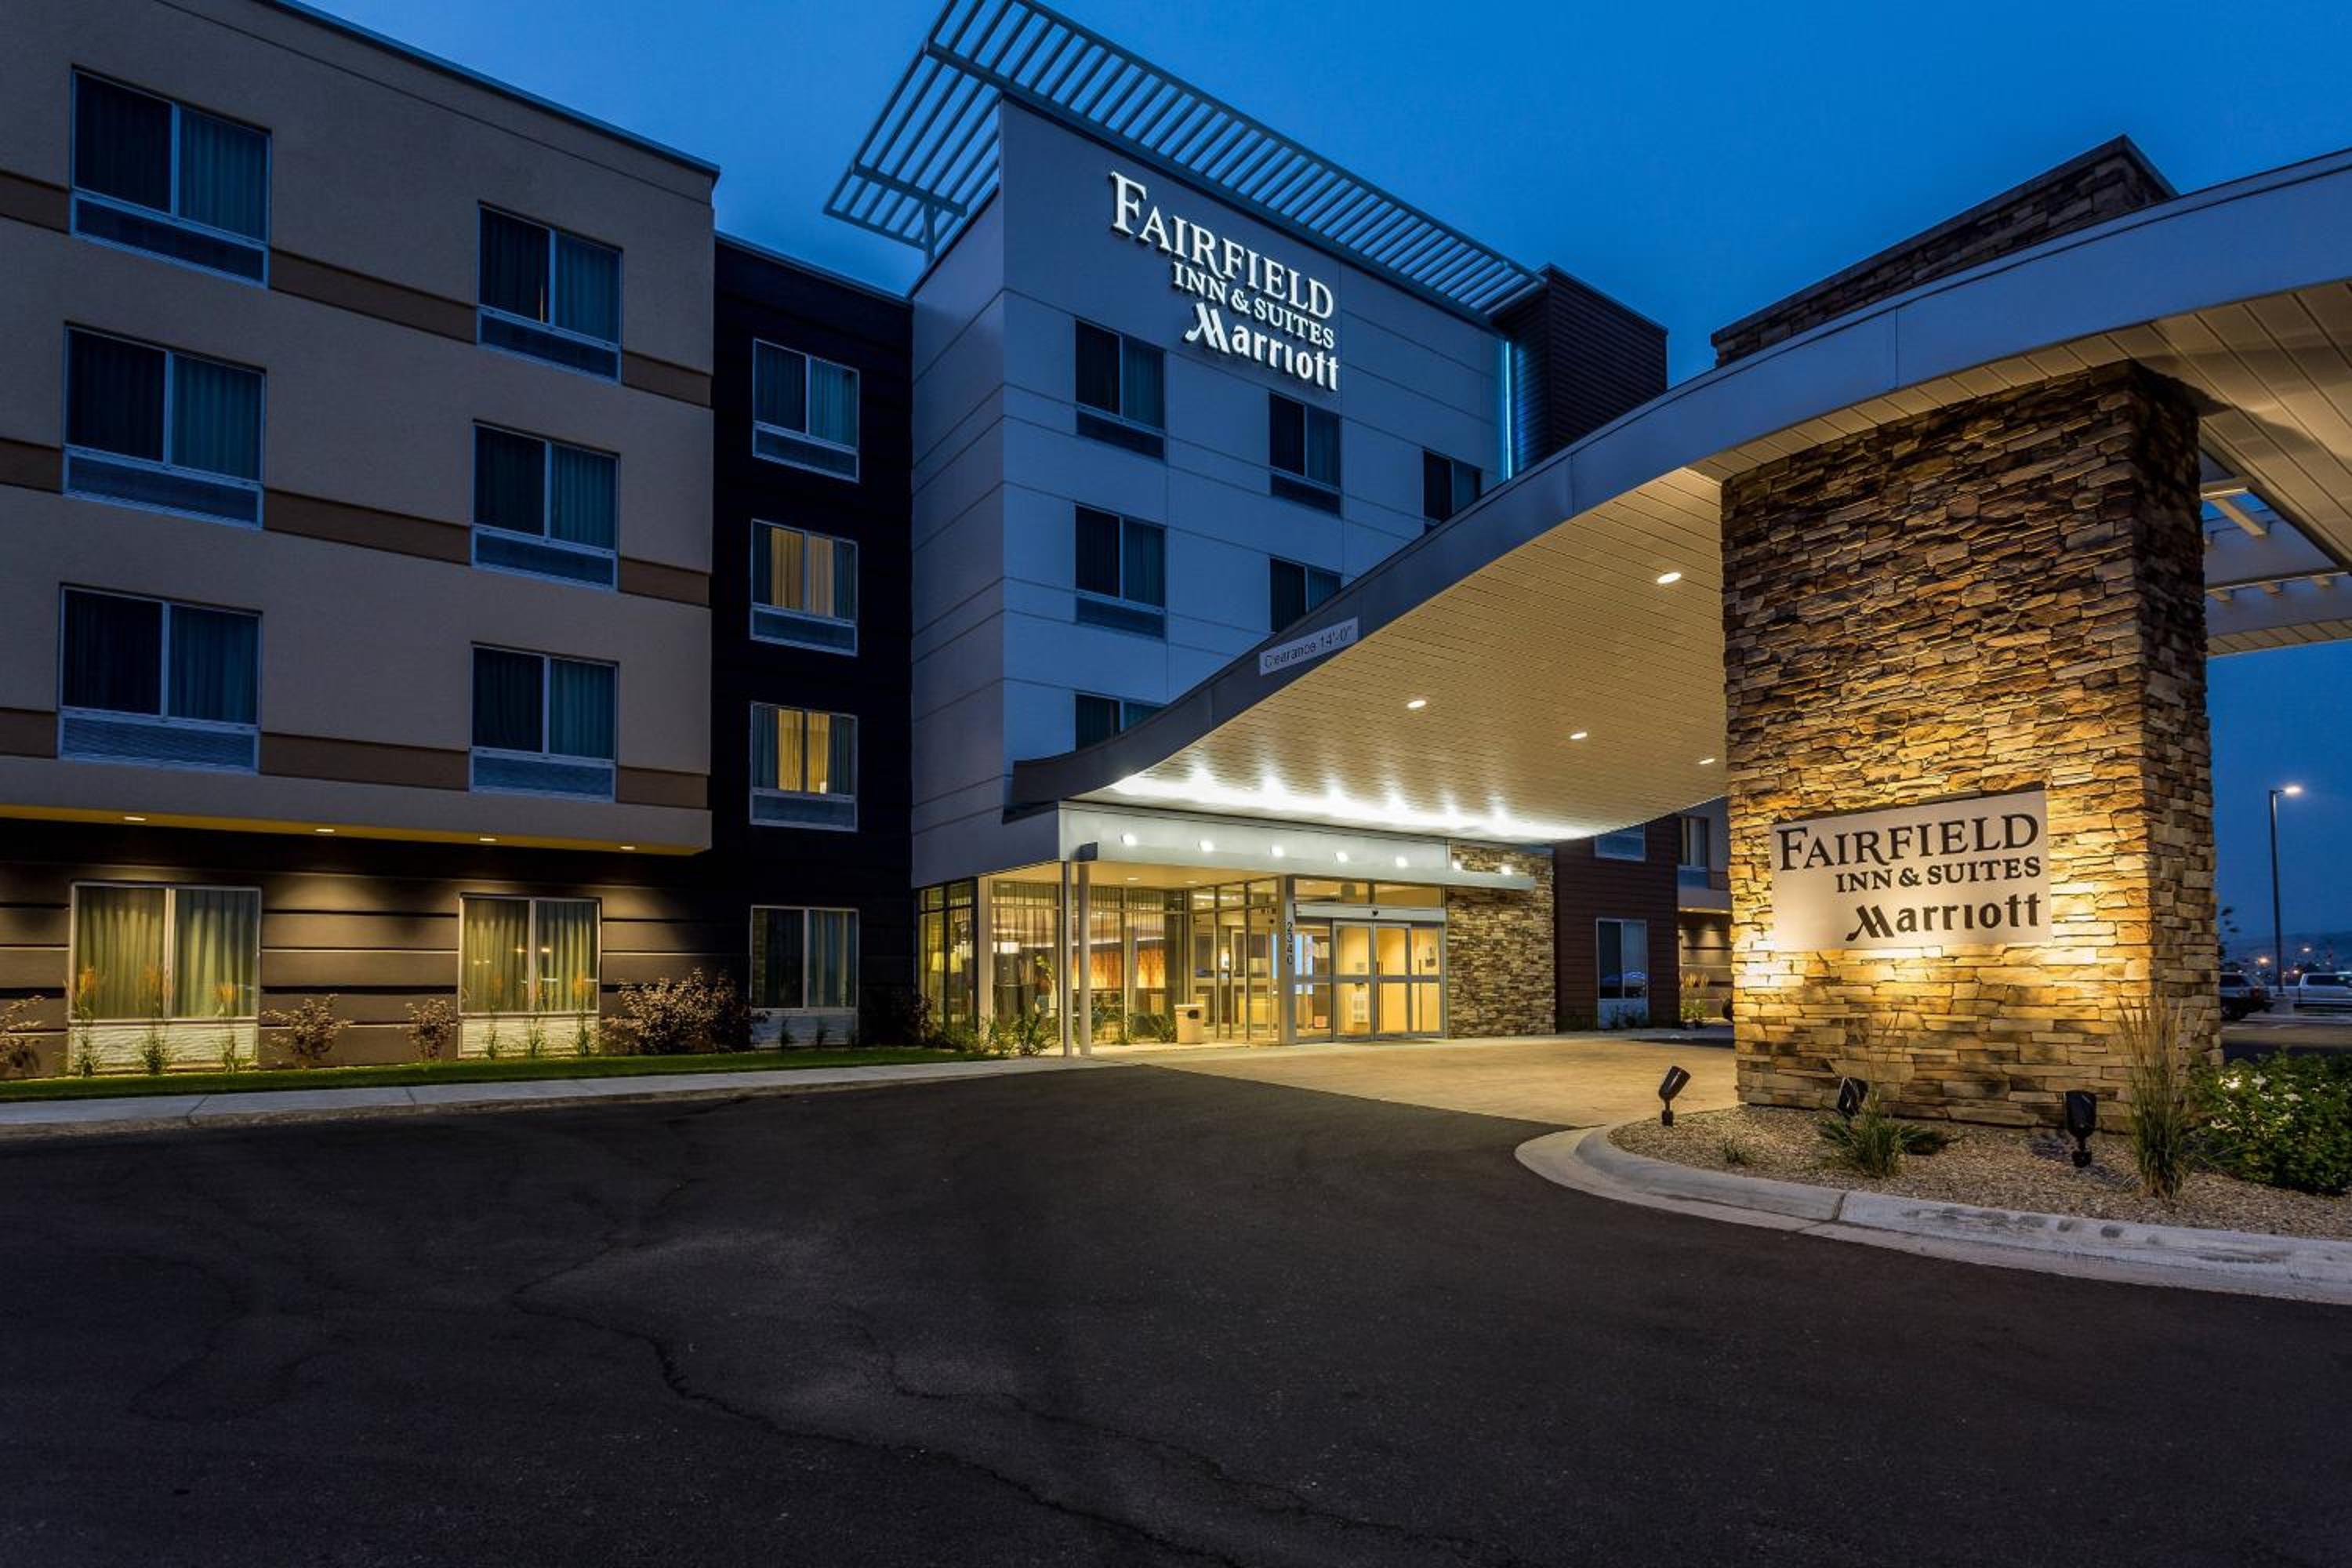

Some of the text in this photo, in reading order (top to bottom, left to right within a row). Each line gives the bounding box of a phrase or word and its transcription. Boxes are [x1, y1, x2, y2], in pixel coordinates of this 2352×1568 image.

[1109, 170, 1334, 319] FAIRFIELD
[1173, 261, 1334, 349] INN & SUITES
[1185, 302, 1340, 391] Marriott
[1264, 641, 1316, 667] Clearance
[1776, 813, 2039, 871] FAIRFIELD
[1835, 855, 2042, 893] INN & SUITES
[1845, 891, 2041, 941] Marriott
